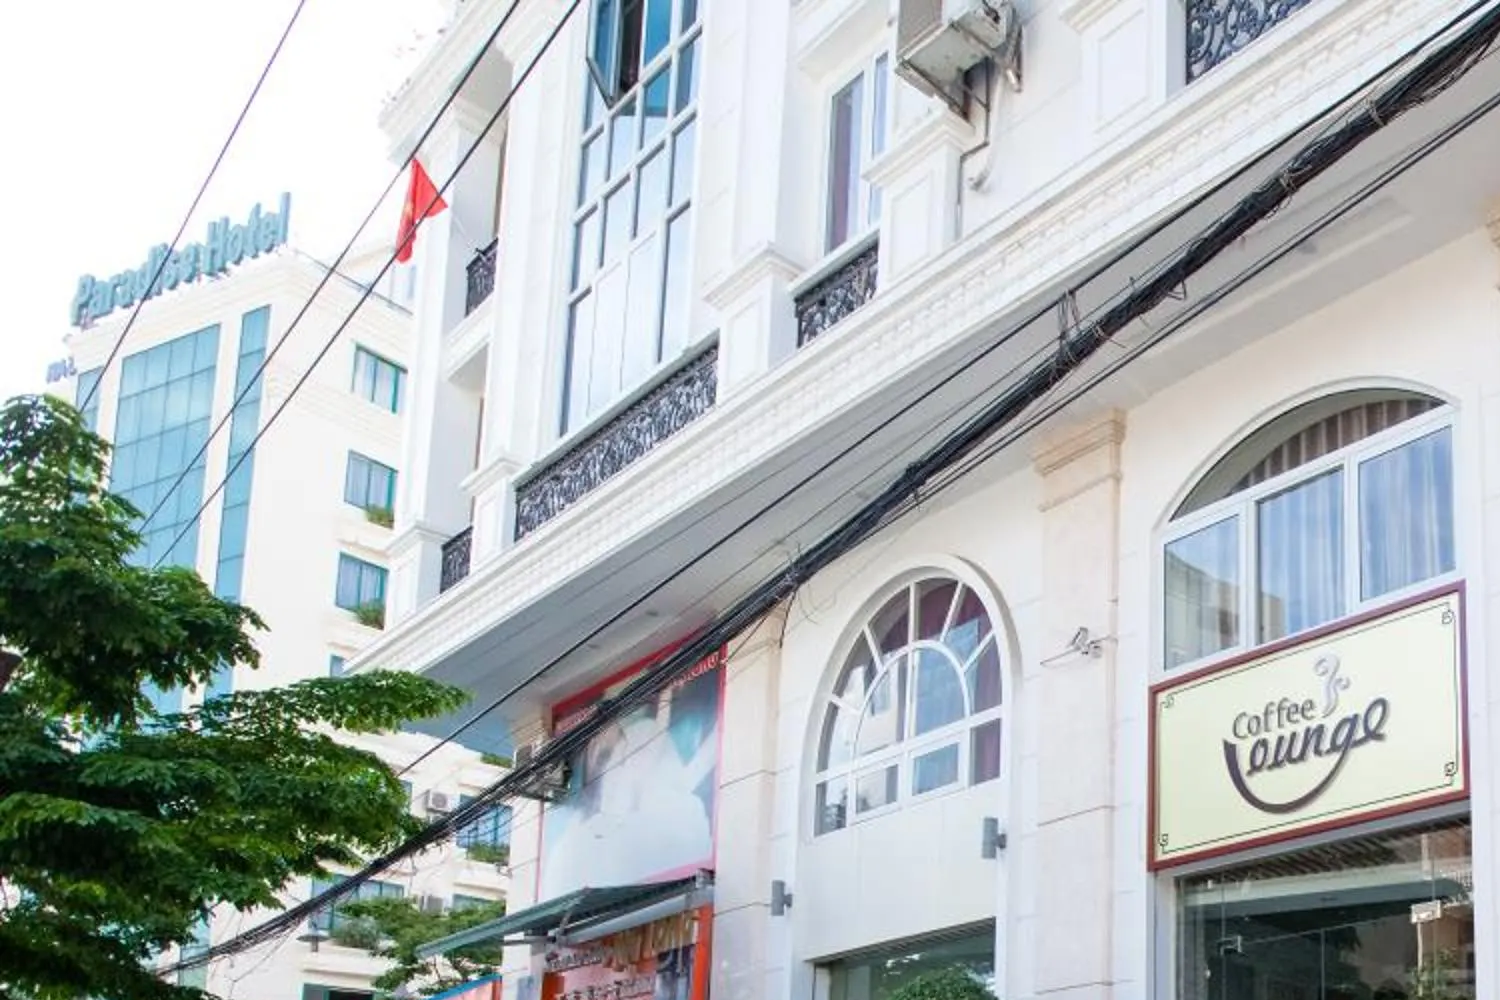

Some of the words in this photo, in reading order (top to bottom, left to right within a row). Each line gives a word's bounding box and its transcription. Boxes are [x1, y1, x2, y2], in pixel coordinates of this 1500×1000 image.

[71, 243, 201, 326] Paradise
[202, 192, 291, 276] Hotel
[1222, 697, 1389, 815] Lounge
[1232, 697, 1316, 740] Coffee
